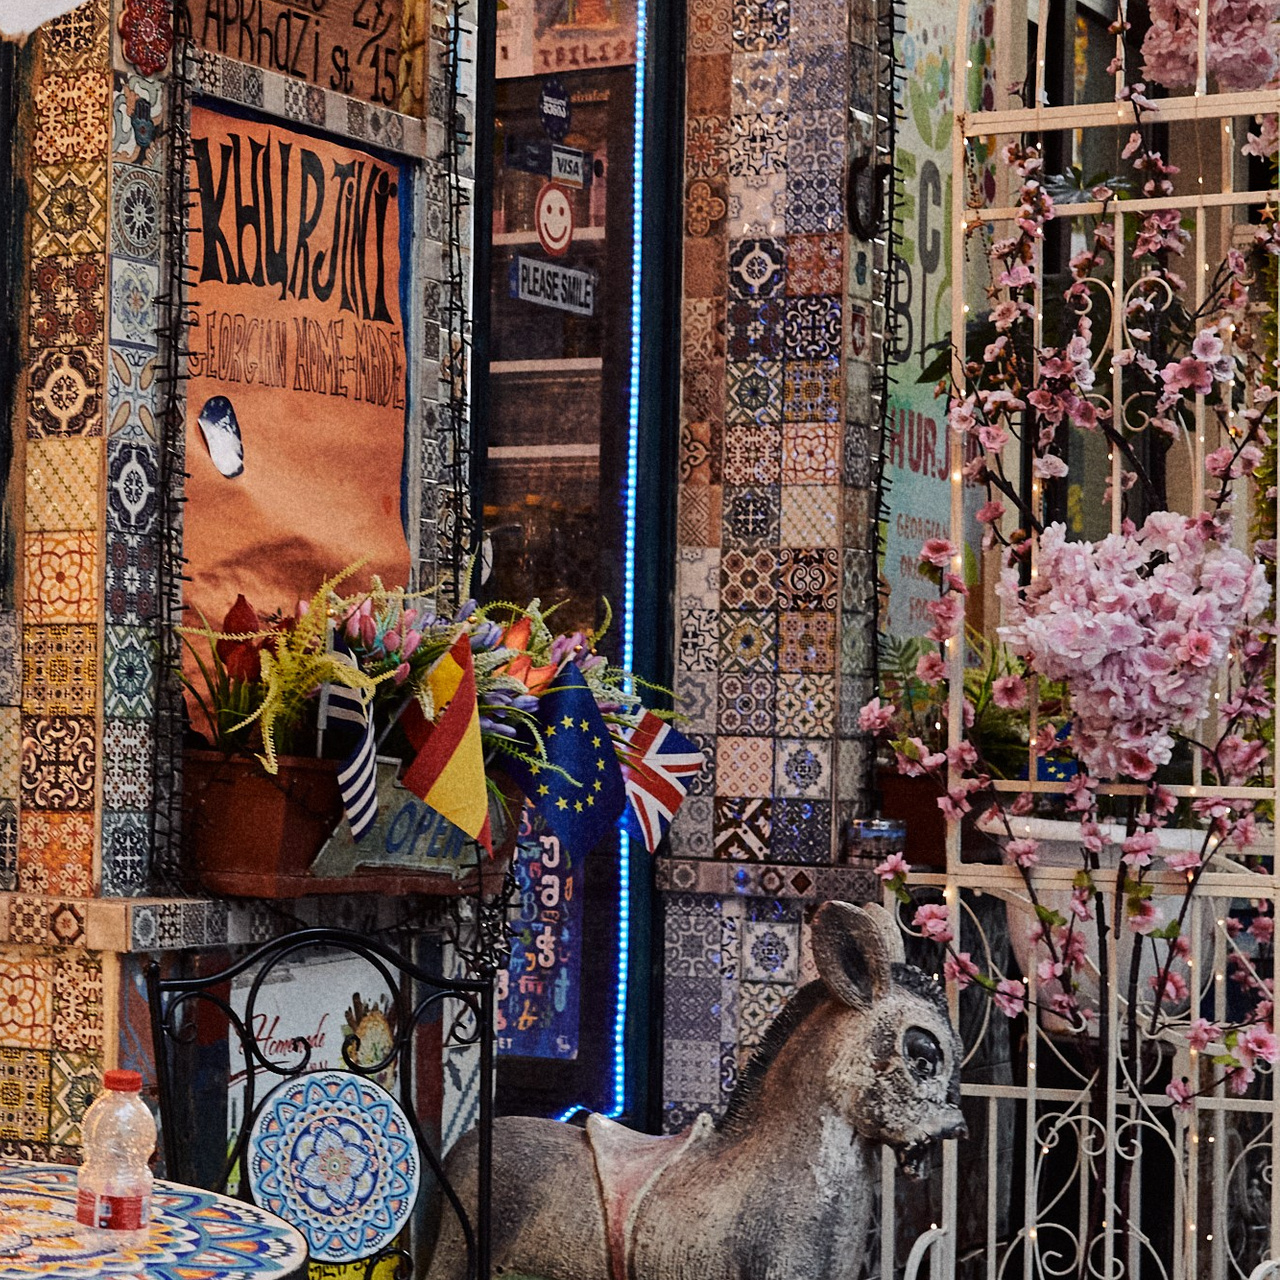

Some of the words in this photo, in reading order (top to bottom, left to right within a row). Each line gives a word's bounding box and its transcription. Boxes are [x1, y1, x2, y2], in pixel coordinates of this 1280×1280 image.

[556, 156, 580, 177] VISA
[521, 263, 560, 302] PLEASE
[560, 273, 592, 310] SMILE
[385, 801, 465, 860] OPEN
